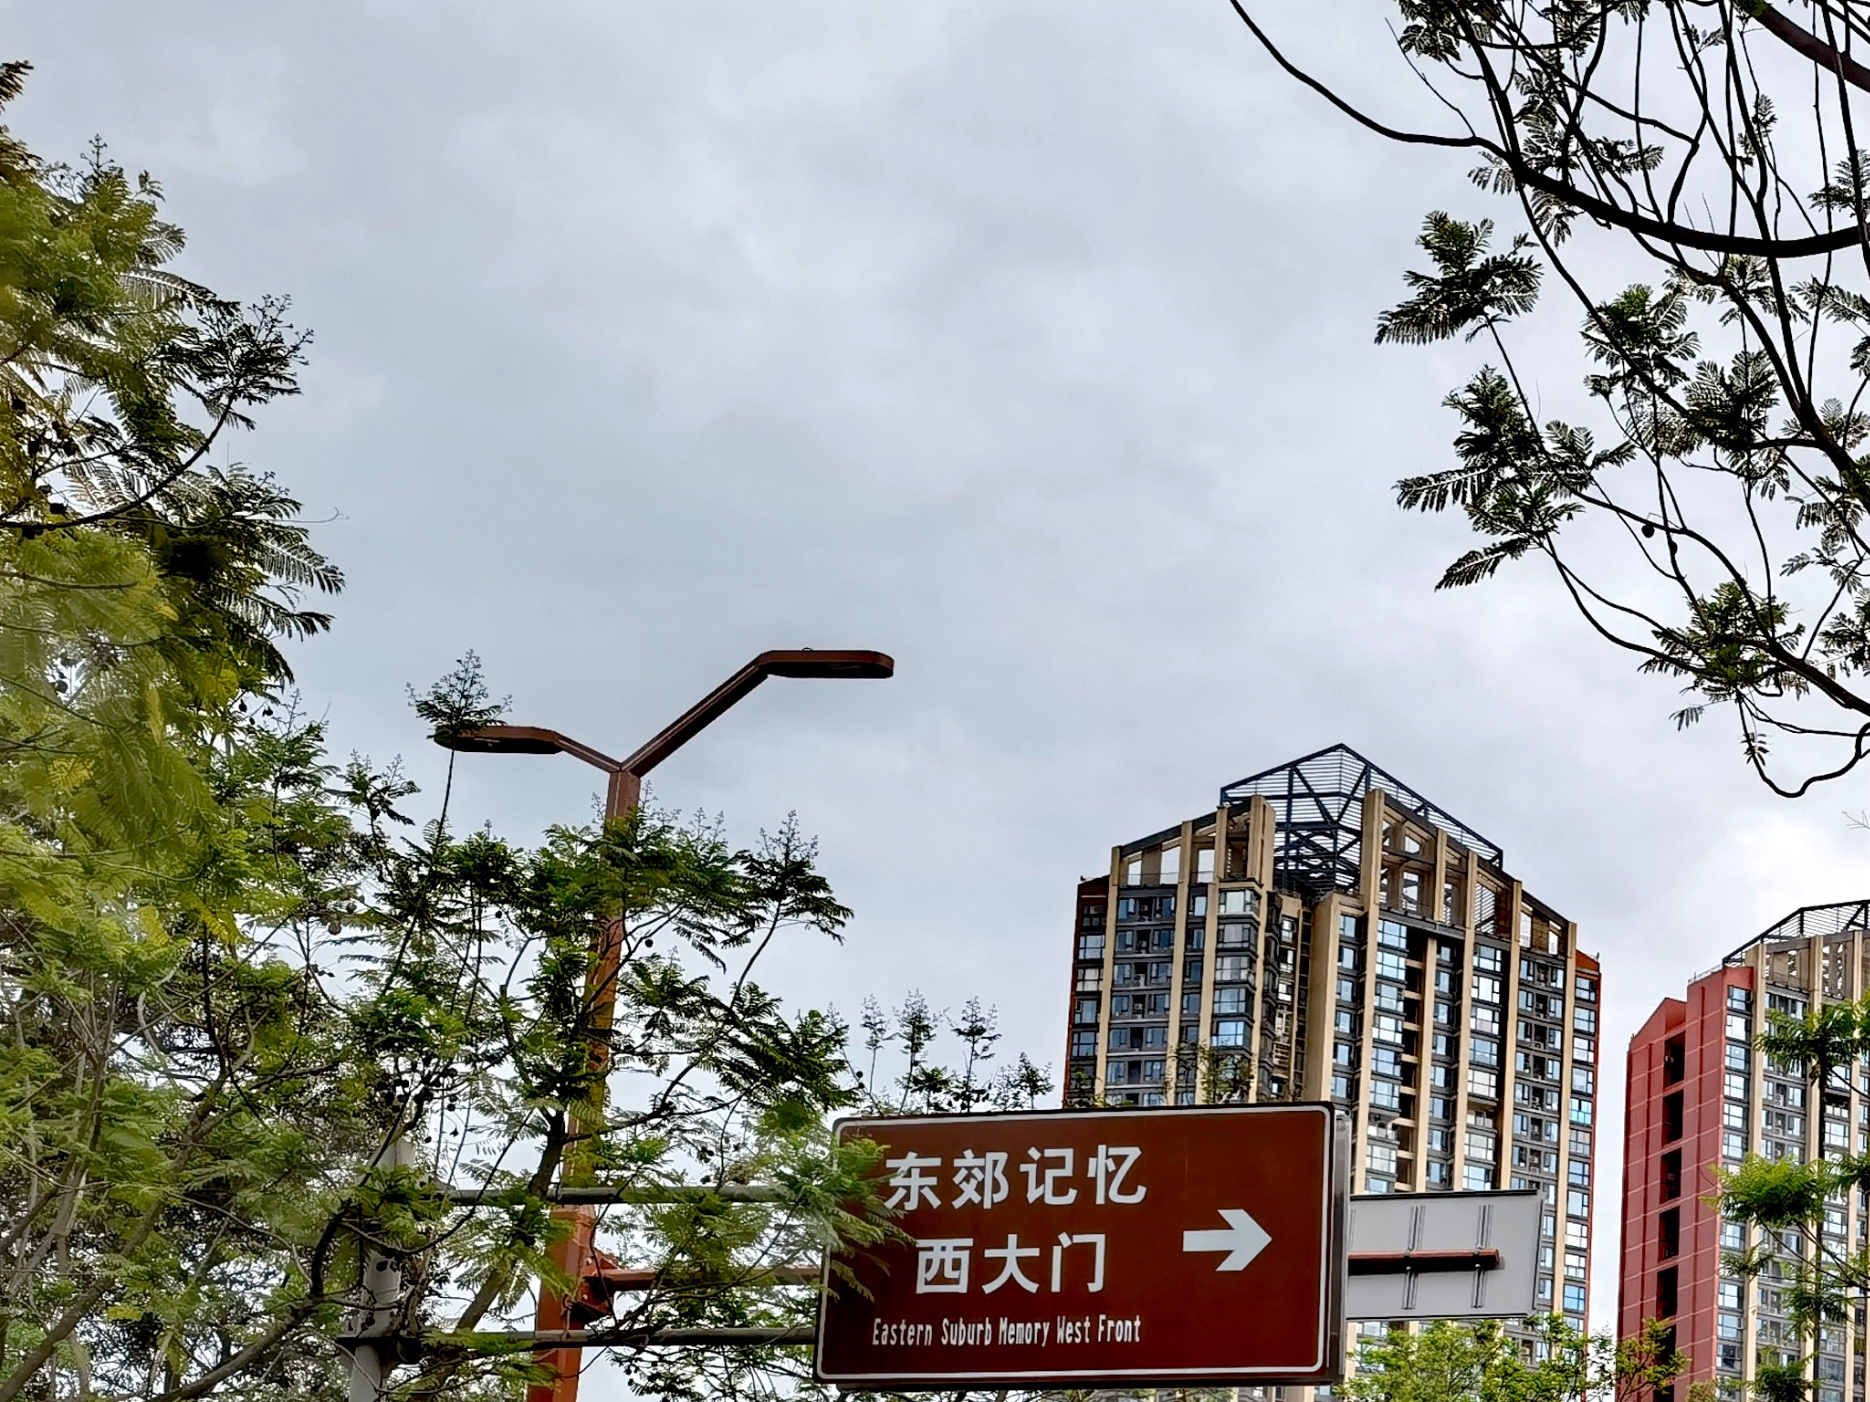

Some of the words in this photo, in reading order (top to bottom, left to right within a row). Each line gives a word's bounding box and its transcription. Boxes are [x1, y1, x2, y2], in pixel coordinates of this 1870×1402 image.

[883, 1144, 1148, 1210] 东郊记忆
[915, 1233, 1108, 1295] 西大门
[871, 1317, 933, 1346] Eastern
[940, 1316, 993, 1347] Suburb
[997, 1316, 1050, 1348] Memory
[1056, 1315, 1091, 1344] West
[1097, 1314, 1142, 1343] Front
